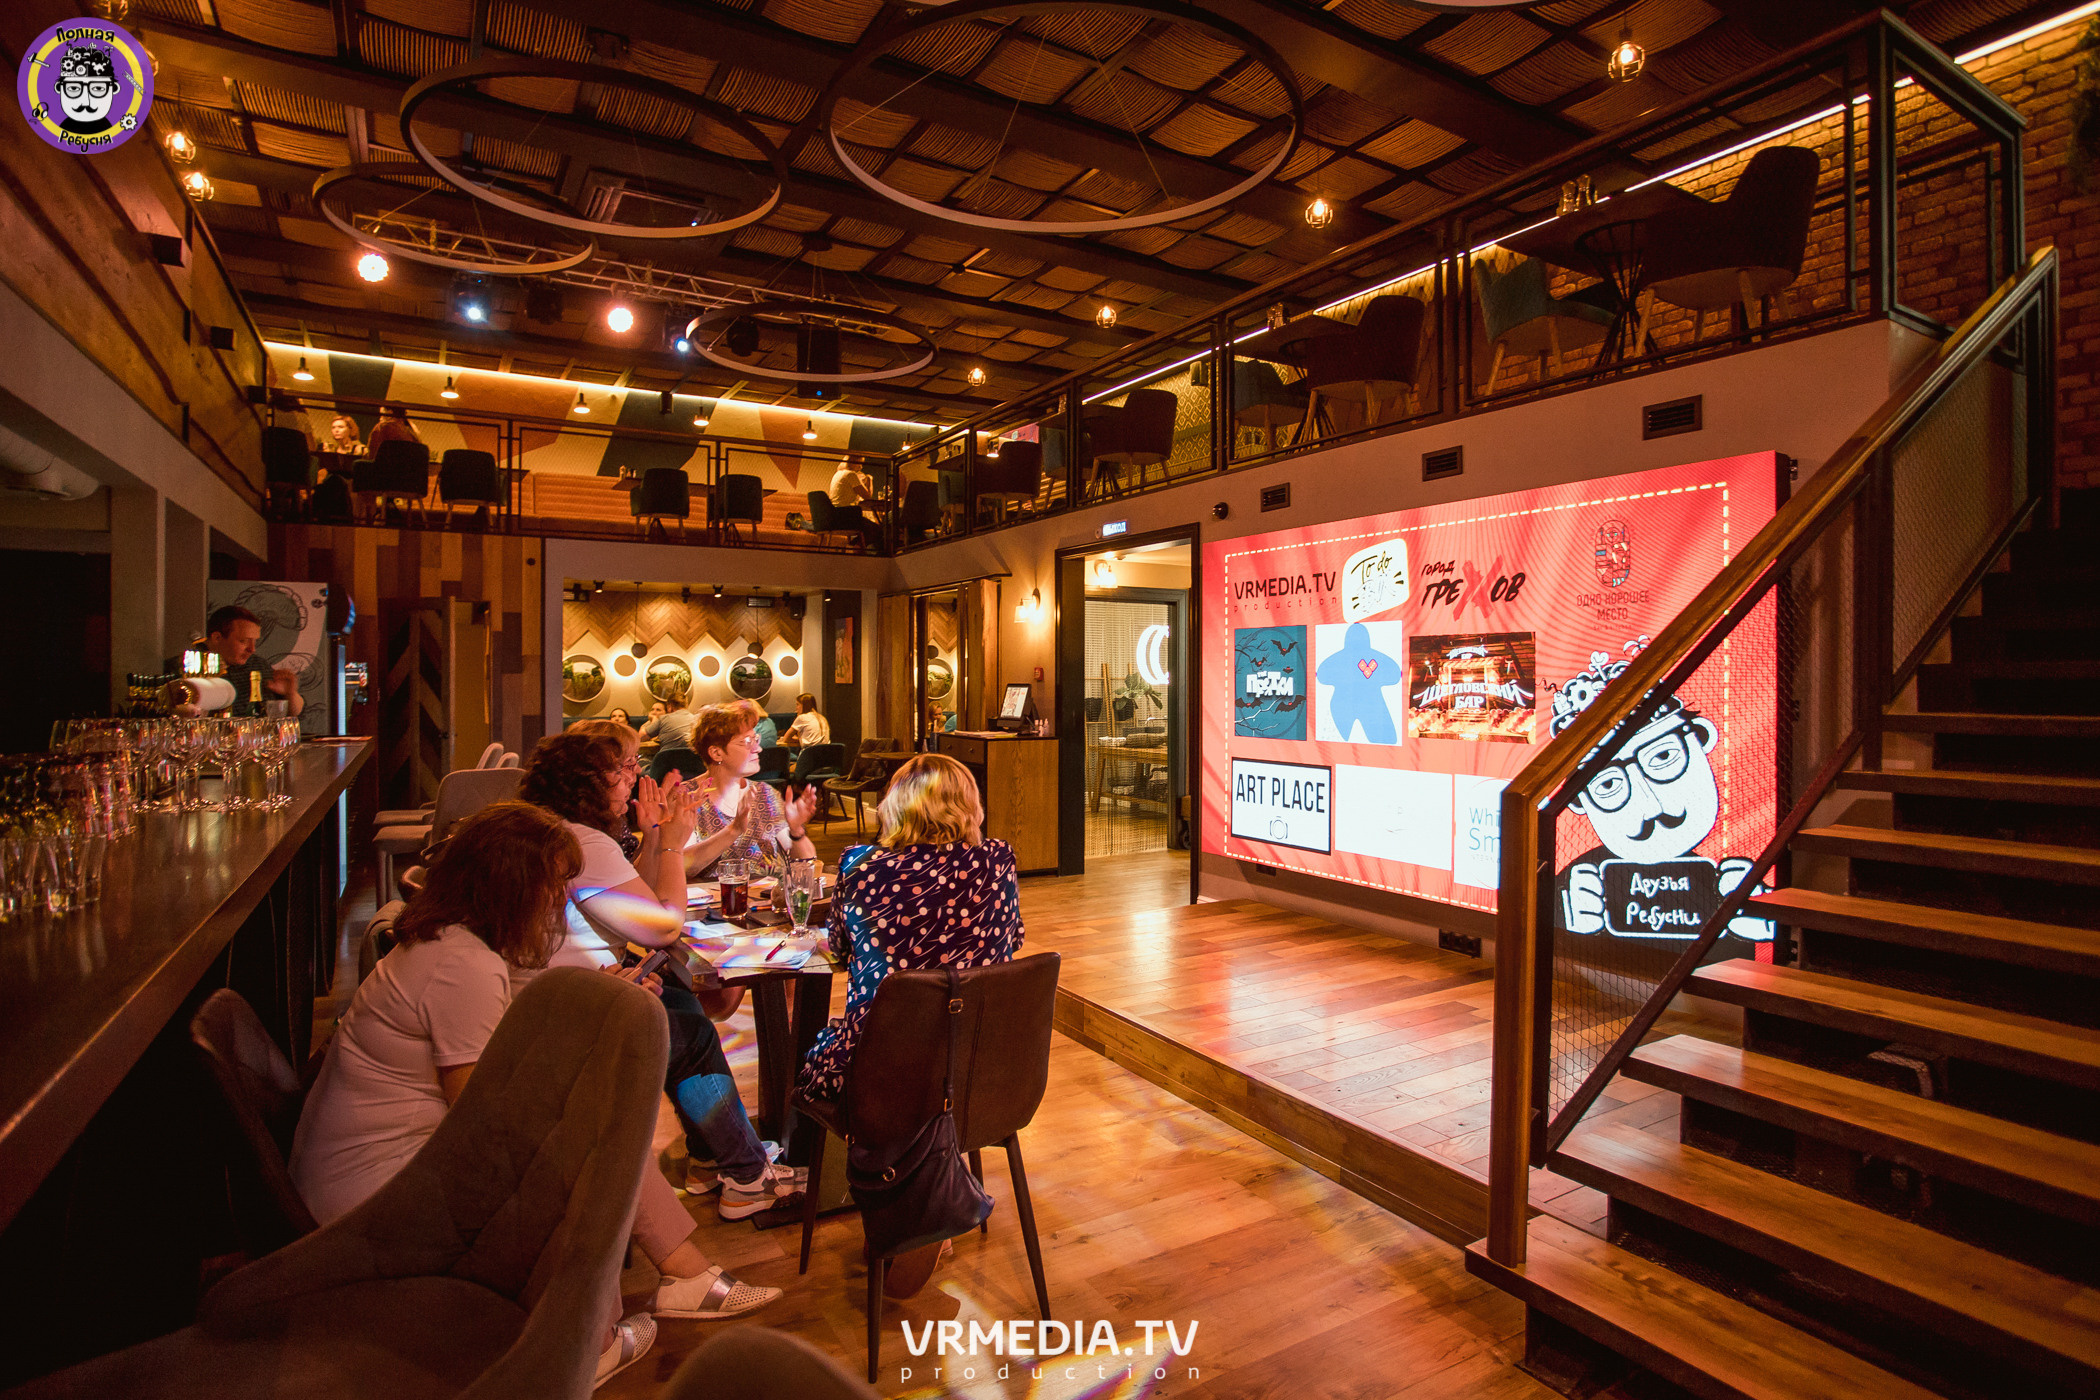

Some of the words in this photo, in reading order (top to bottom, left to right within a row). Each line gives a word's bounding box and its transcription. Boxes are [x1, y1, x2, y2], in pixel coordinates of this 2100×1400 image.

[1234, 571, 1337, 600] VRMEDIA.TV
[1233, 595, 1337, 613] production
[1596, 607, 1629, 621] МЕСТО
[1454, 695, 1485, 711] БАР
[1236, 773, 1267, 805] ART
[1271, 777, 1326, 814] PLACE
